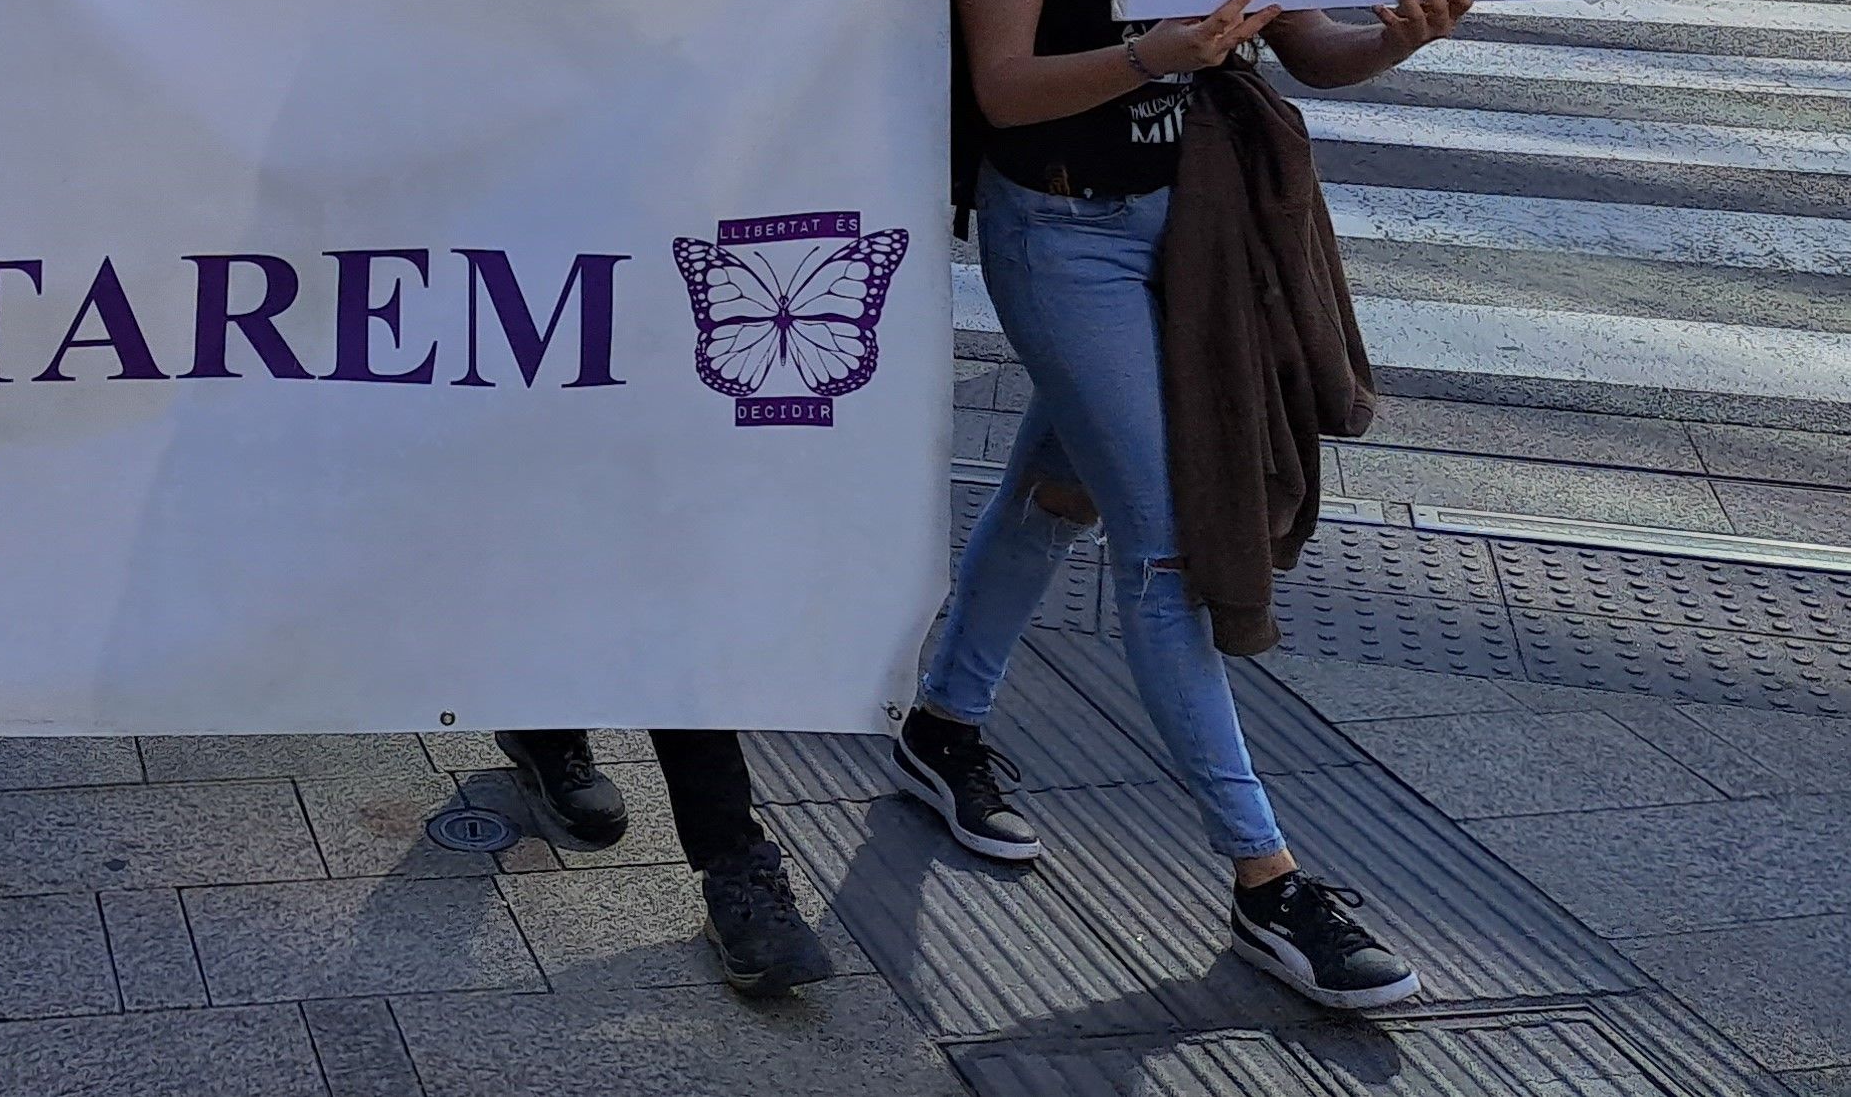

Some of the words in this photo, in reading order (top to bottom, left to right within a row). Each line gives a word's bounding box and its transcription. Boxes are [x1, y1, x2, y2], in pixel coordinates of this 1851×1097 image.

[719, 218, 822, 240] LLIBERTAT
[835, 213, 859, 233] ÉS
[736, 404, 832, 420] DECIDIR
